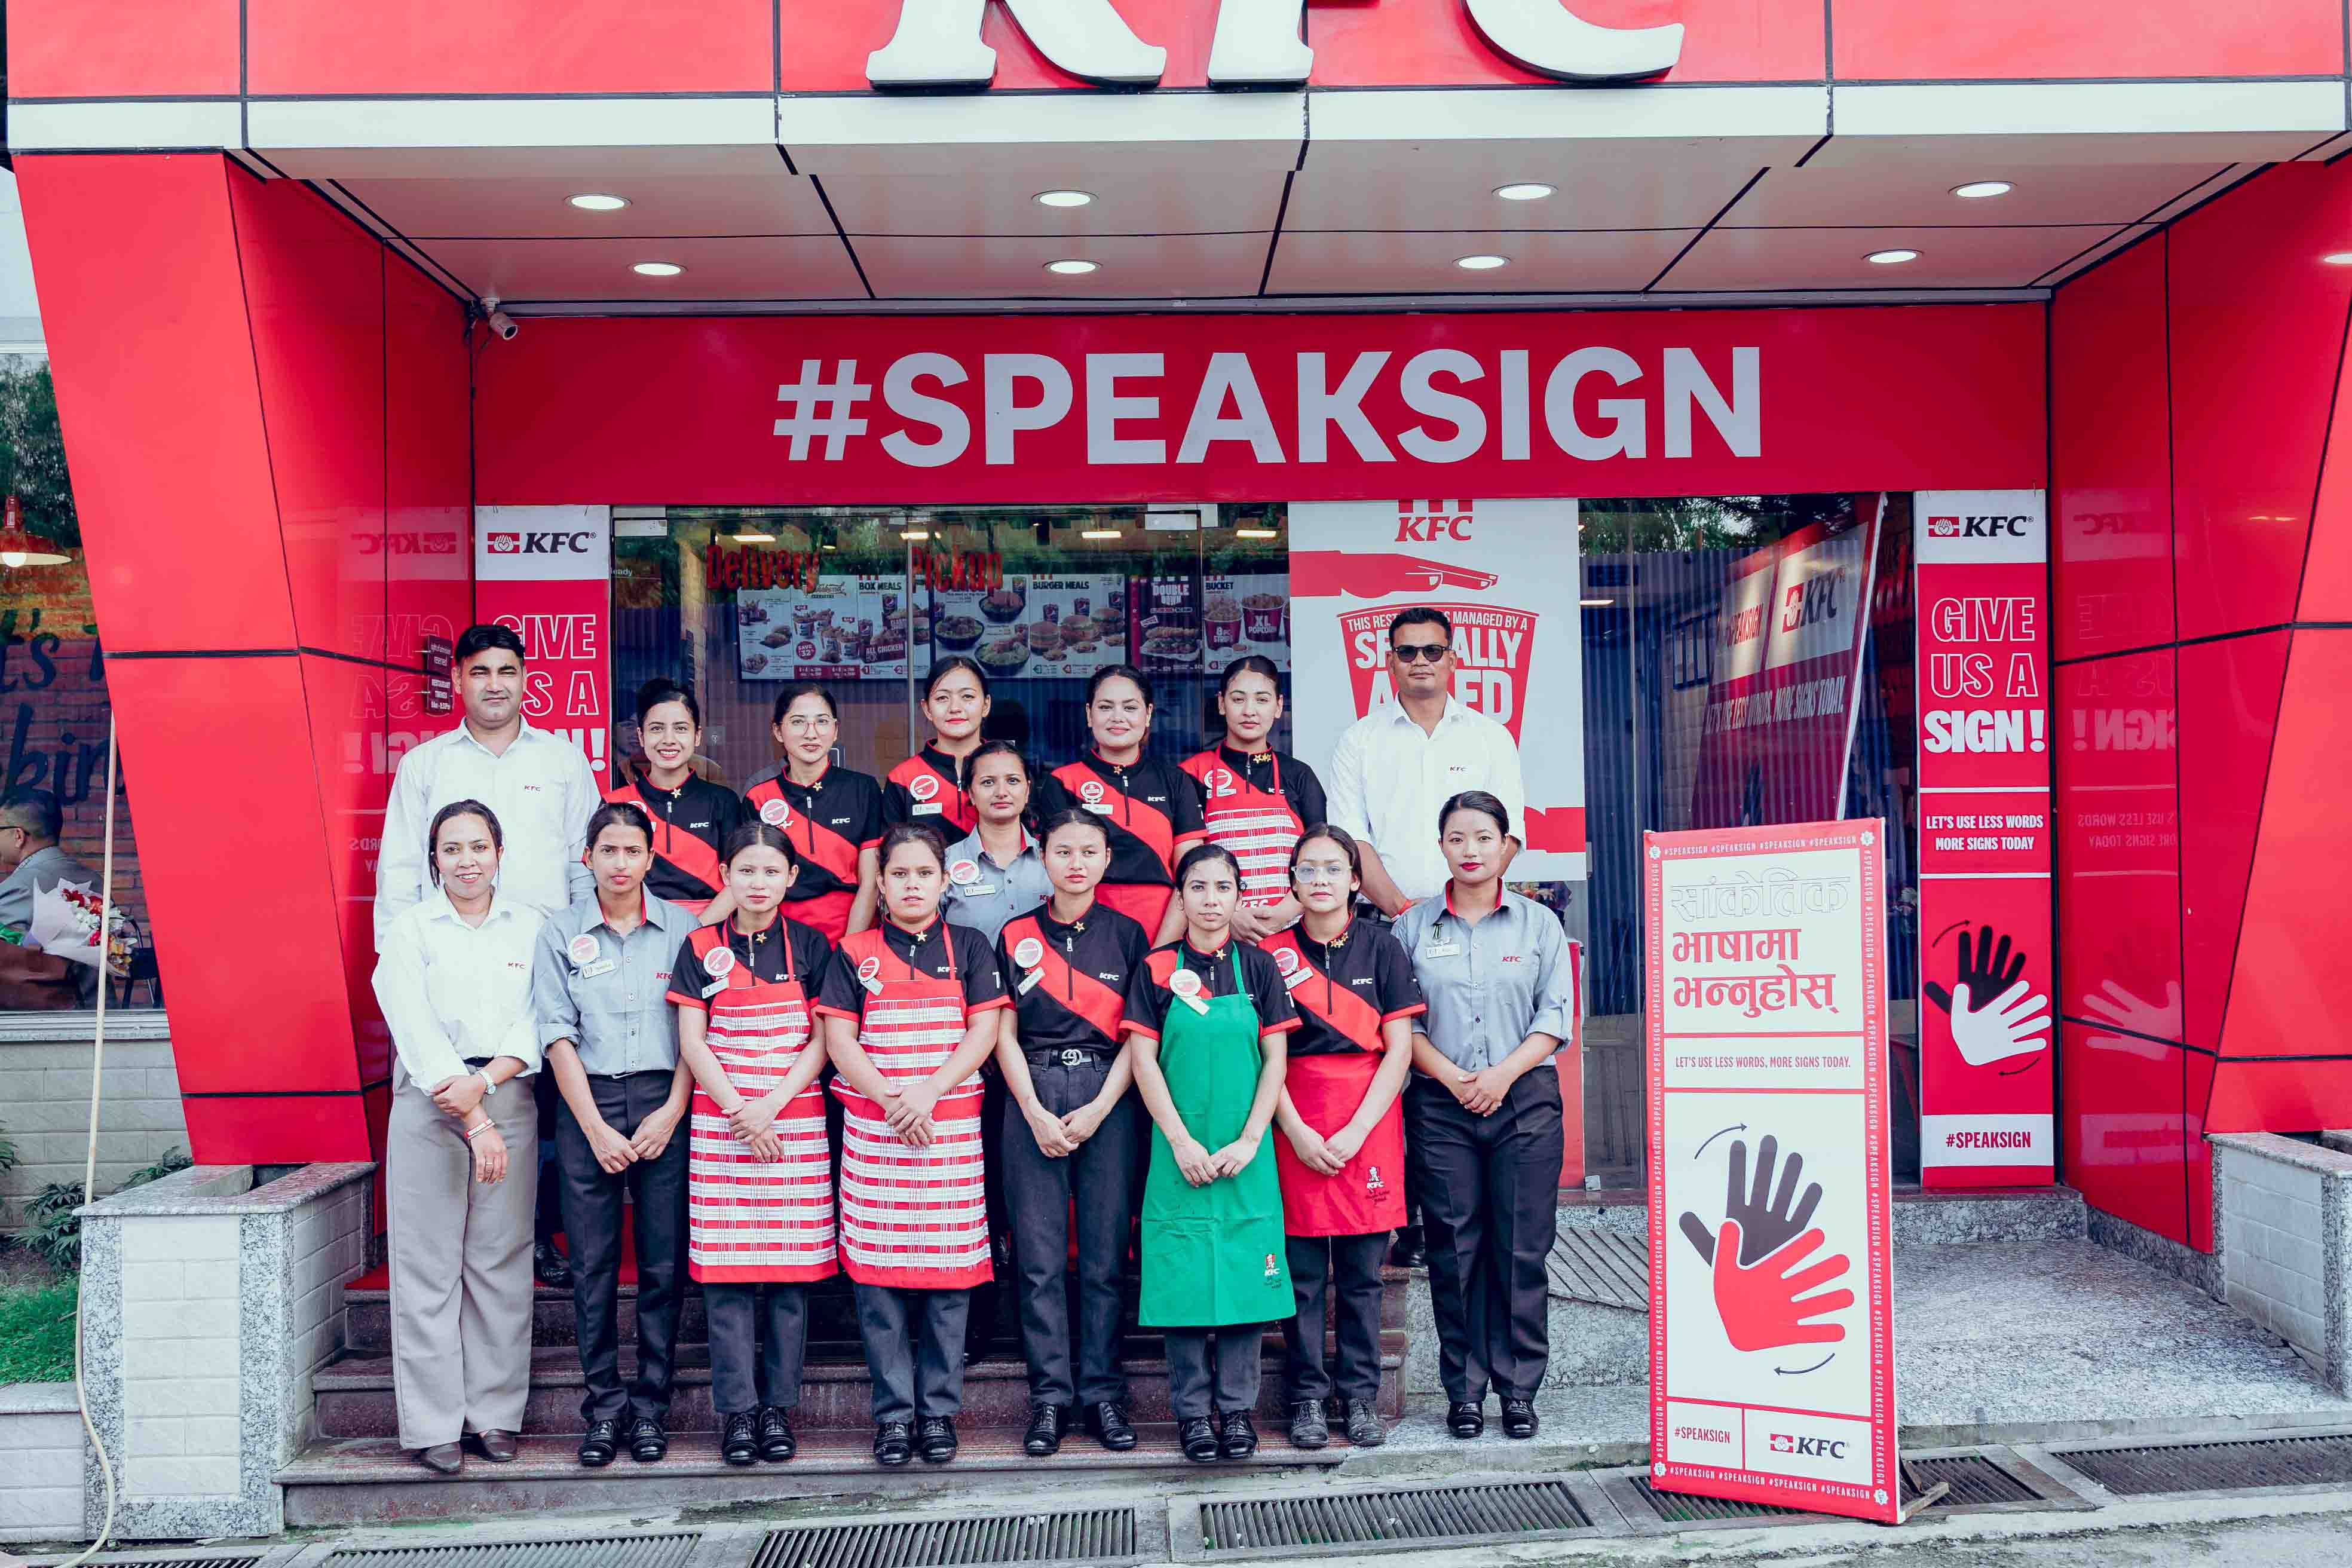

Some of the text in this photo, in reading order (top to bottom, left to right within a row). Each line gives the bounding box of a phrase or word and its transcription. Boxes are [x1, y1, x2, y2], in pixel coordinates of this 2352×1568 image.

[773, 346, 1760, 468] #SPEAKSIGN
[1395, 516, 1472, 541] KFC
[707, 544, 820, 593] Delivery
[912, 544, 1003, 593] Pickup
[878, 582, 902, 590] MEALS
[1153, 584, 1190, 596] DOUBLE
[1255, 615, 1271, 626] XL
[1348, 617, 1370, 632] THIS
[1453, 611, 1502, 626] MANAGED
[1505, 615, 1519, 629] BY
[1520, 618, 1527, 630] A
[1931, 598, 2035, 642] GIVE
[877, 643, 904, 654] CHICKEN
[1355, 627, 1524, 669] SPALLY
[1931, 653, 1993, 698] US
[2006, 653, 2038, 697] A
[522, 671, 599, 716] S A
[1368, 669, 1513, 725] AED
[1926, 815, 2043, 829] LET'S USE LESS WORDS
[1936, 837, 2034, 851] MORE SIGNS TODAY
[1673, 929, 1802, 963] भाषामा
[1100, 973, 1119, 981] KFC
[1673, 964, 1840, 1018] भन्नुहोस्
[1676, 1056, 1850, 1069] LET'S USE LESS WORDS, MORE SIGNS TODAY.
[1946, 1131, 2031, 1148] #SPEAKSIGN
[1264, 1268, 1281, 1276] KFC
[1675, 1426, 1731, 1444] #SPEAKSIGN
